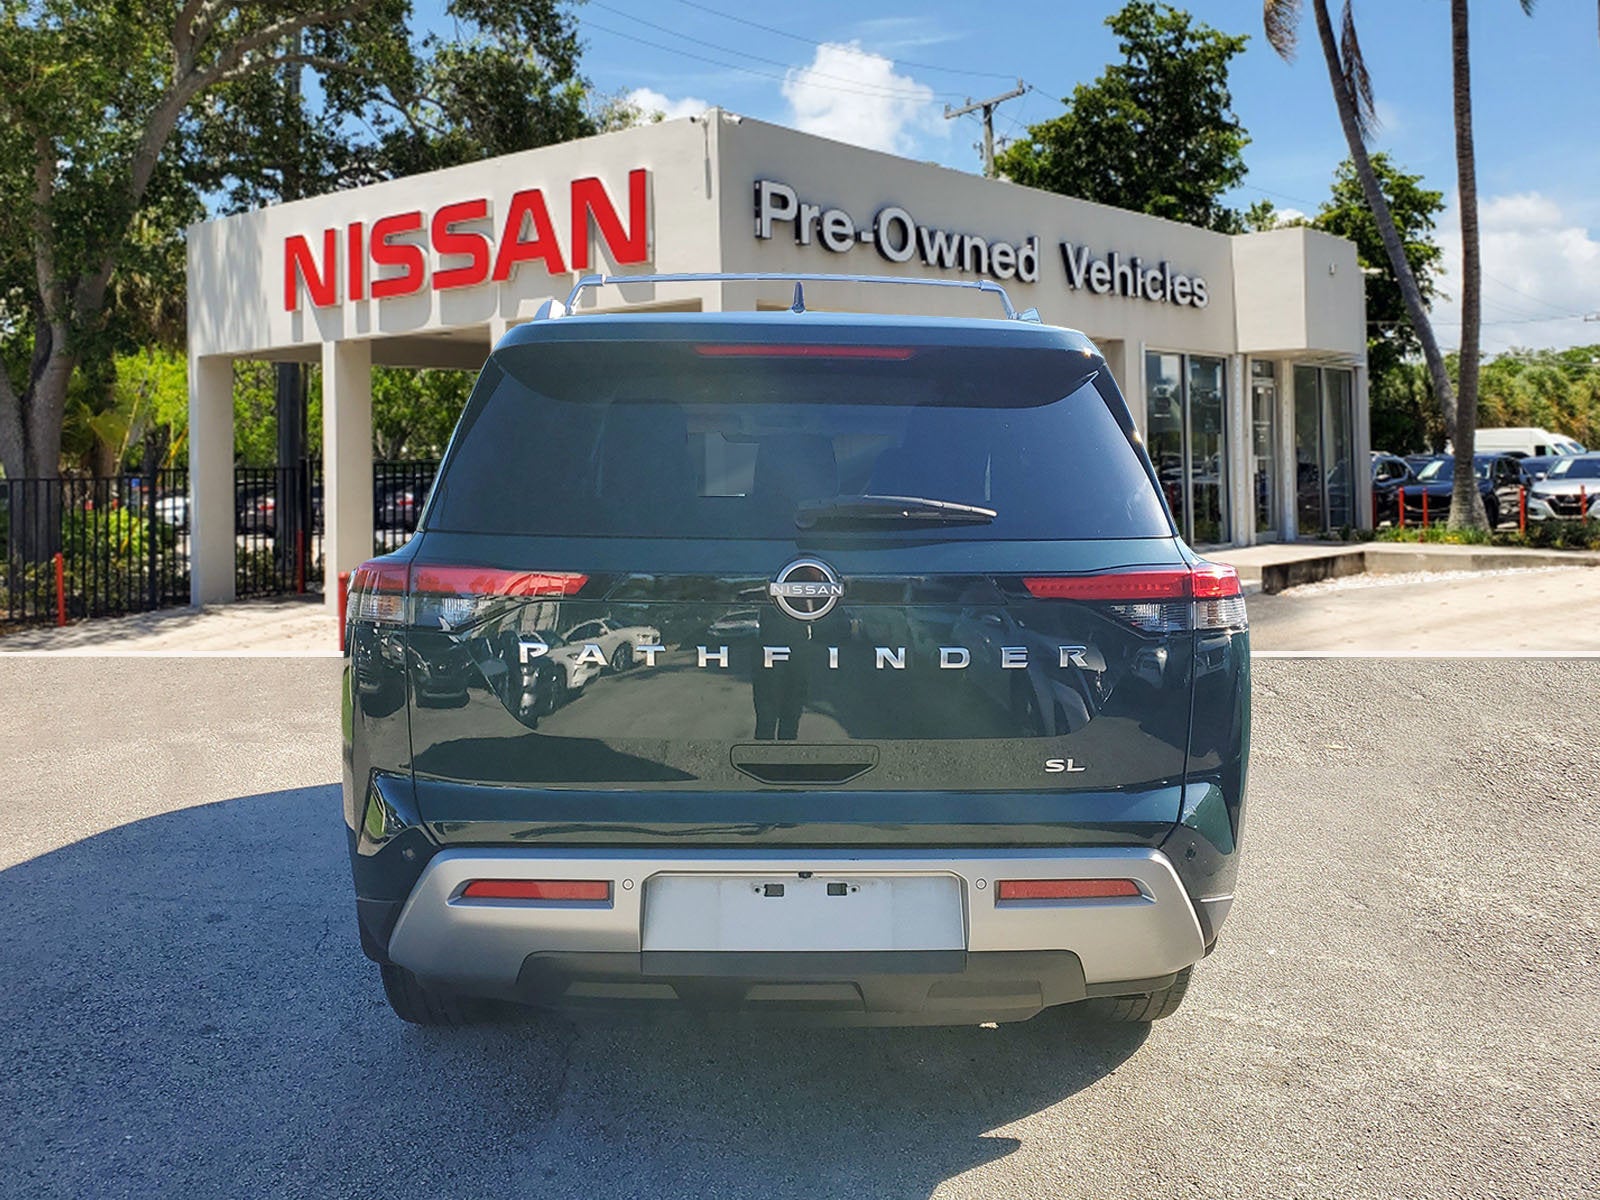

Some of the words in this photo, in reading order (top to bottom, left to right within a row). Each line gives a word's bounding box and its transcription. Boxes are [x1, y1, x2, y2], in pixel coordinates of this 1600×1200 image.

[284, 168, 647, 312] NISSAN
[754, 179, 1040, 283] Pre-Owned
[1060, 241, 1209, 309] Vehicles
[772, 584, 843, 596] NISSAN
[518, 642, 1090, 670] PATHFINDER
[1044, 758, 1086, 773] SL
